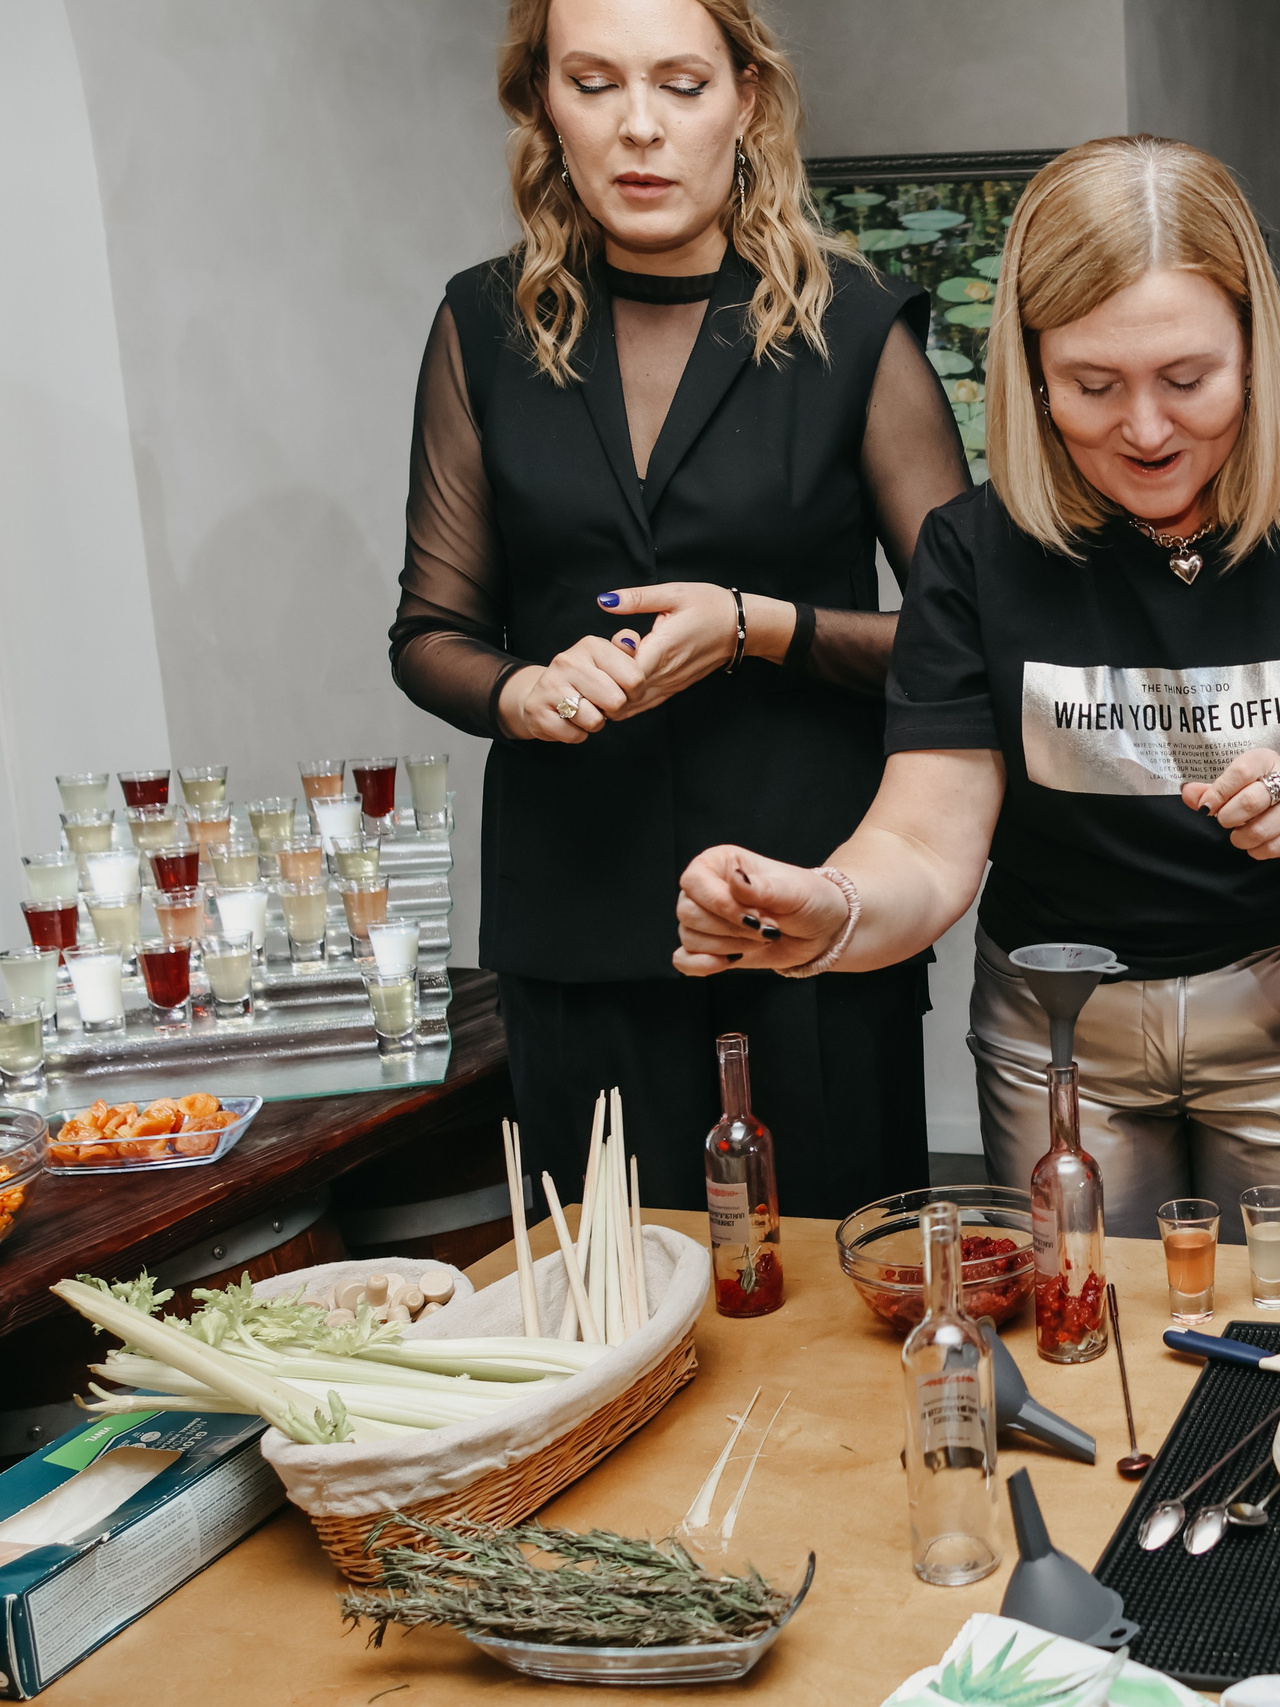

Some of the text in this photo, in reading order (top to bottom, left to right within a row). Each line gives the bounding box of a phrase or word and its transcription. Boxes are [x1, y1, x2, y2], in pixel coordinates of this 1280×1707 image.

[1142, 682, 1230, 695] THE THINGS TO DO
[1054, 700, 1124, 731] WHEN
[1128, 704, 1172, 731] YOU
[1180, 704, 1222, 733] ARE
[1178, 750, 1209, 758] FAVOURITE
[1221, 749, 1245, 757] SERIES
[84, 1426, 113, 1442] VINYL
[178, 1431, 208, 1453] GLOV
